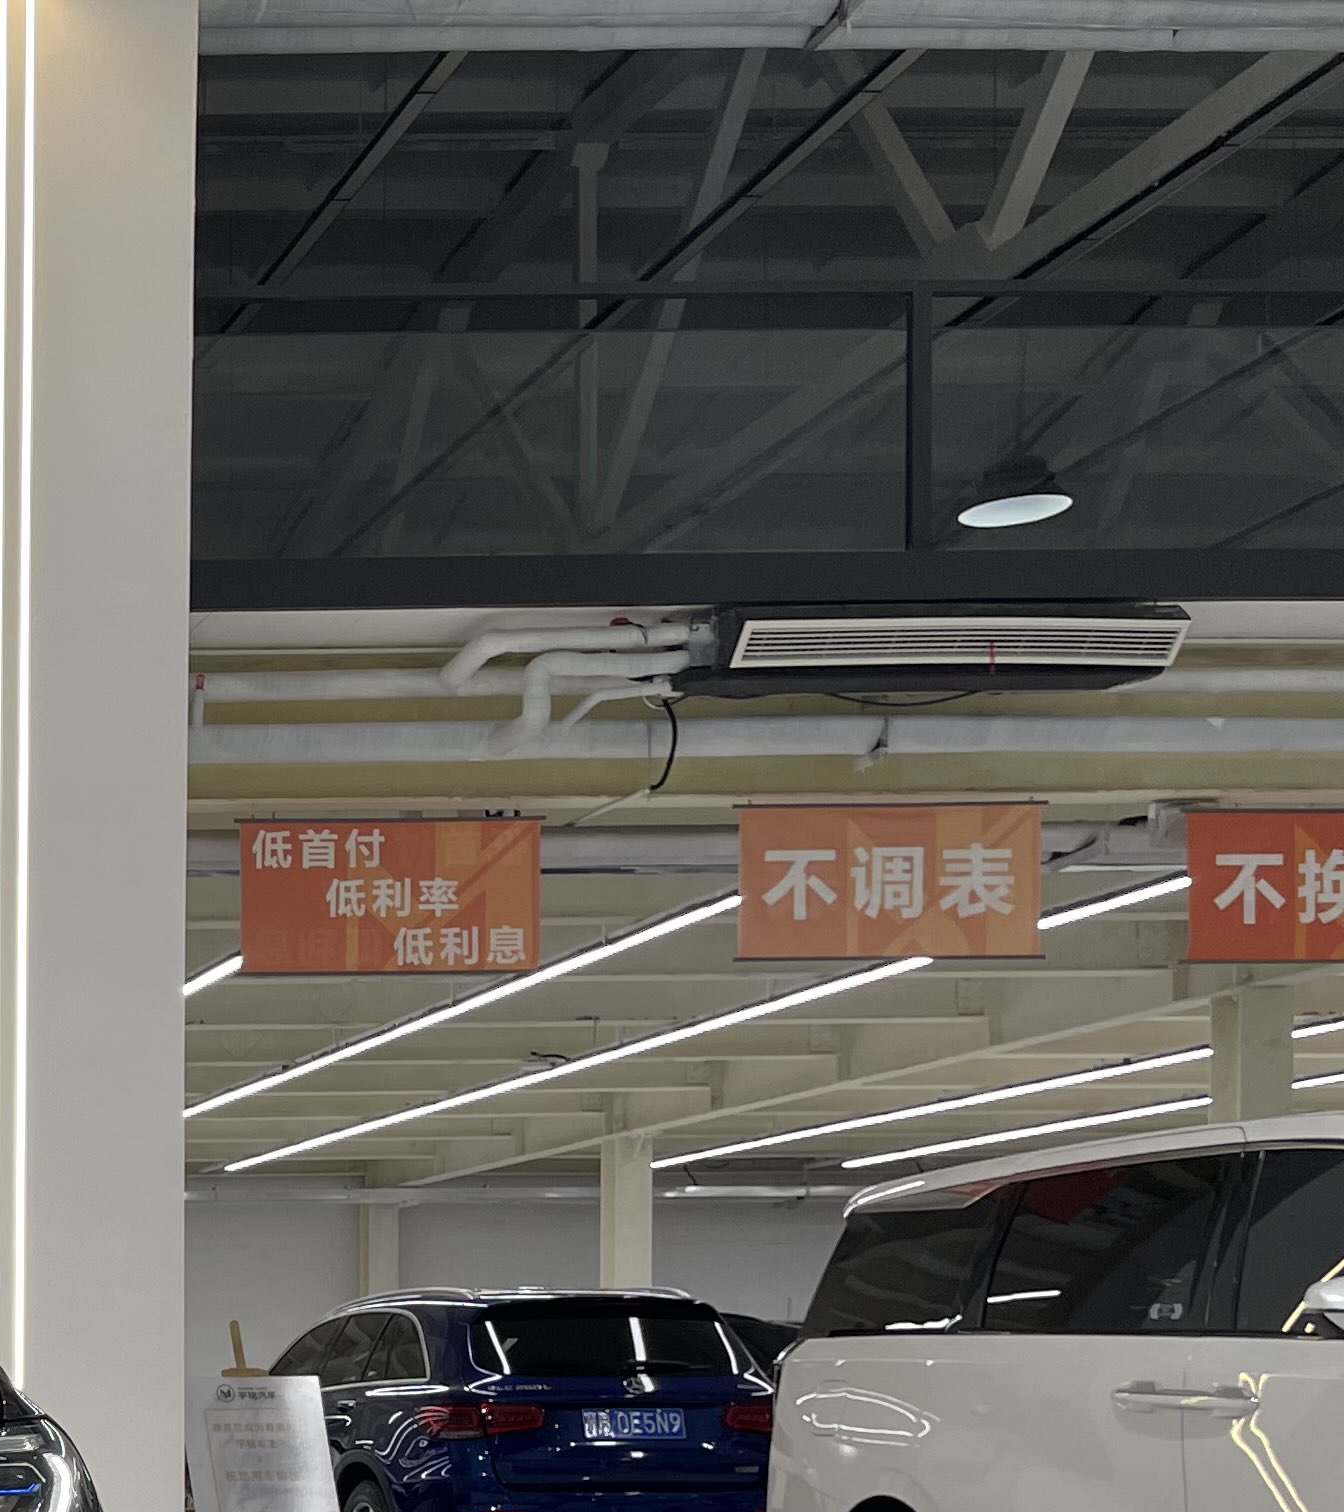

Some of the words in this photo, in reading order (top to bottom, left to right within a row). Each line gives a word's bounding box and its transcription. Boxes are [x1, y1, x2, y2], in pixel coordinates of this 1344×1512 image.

[252, 829, 385, 869] 低首付
[325, 877, 460, 918] 低利率
[762, 842, 1015, 920] 不调表
[393, 926, 527, 966] 低利息
